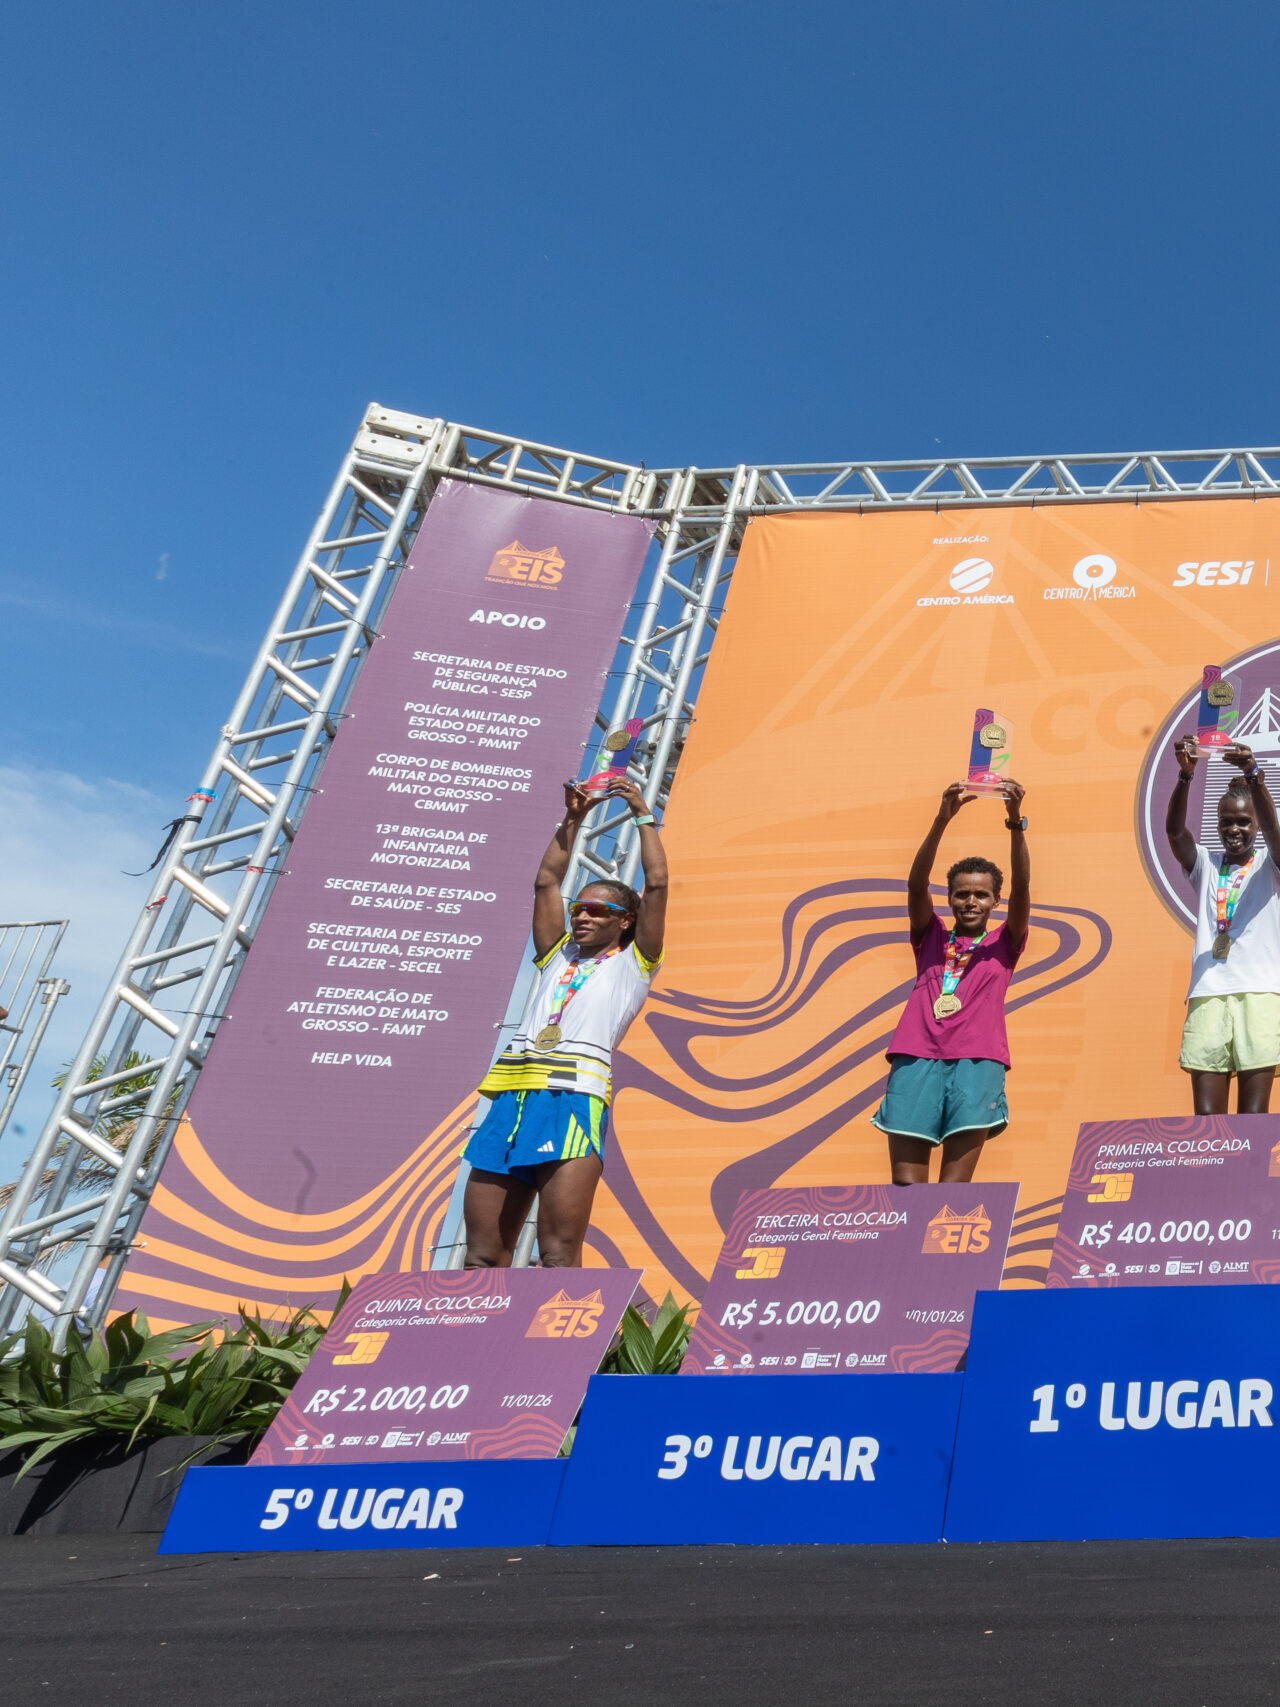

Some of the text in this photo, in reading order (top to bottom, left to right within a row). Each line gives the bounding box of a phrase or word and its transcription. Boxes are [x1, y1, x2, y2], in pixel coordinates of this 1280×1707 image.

[933, 534, 989, 544] REALIZAÇÃO:
[916, 593, 1014, 606] CENTRO AMÉRICA
[1043, 587, 1084, 600] CENTRO
[470, 609, 546, 630] APOIO
[412, 651, 567, 679] SECRETARIA DE ESTADO
[434, 667, 537, 688] DE SEGURANÇA
[432, 679, 532, 699] PÚBLICA SESP
[404, 702, 541, 726] POLÍCIA MILITAR DO
[408, 716, 528, 738] ESTADO DE MATO
[408, 730, 521, 750] GROSSO PMMT
[376, 753, 532, 779] CORPO DE BOMBEIROS
[368, 766, 531, 792] MILITAR DO ESTADO DE
[387, 782, 493, 802] MATO GROSSO
[414, 799, 469, 813] CBMMT
[401, 826, 465, 841] BRIGADA
[468, 832, 488, 843] DE
[383, 839, 469, 856] INFANTARIA
[370, 852, 470, 871] MOTORIZADA
[324, 878, 496, 902] SECRETARIA DE ESTADO
[351, 895, 462, 914] DE SAÚDE SES
[307, 922, 482, 946] SECRETARIA DE ESTADO
[307, 938, 473, 960] DE CULTURA, ESPORTE
[327, 955, 442, 974] E LAZER SECEL
[316, 987, 433, 1004] FEDERAÇÃO DE
[287, 1001, 448, 1021] ATLETISMO DE MATO
[302, 1018, 426, 1036] GROSSO FAMT
[311, 1052, 392, 1067] HELP VIDA
[1098, 1139, 1250, 1157] PRIMEIRA COLOCADA
[1094, 1156, 1224, 1170] Categoria Geral Feminina
[755, 1212, 907, 1228] TERCEIRA COLOCADA
[748, 1229, 879, 1244] Categoria Geral Feminina
[1079, 1219, 1251, 1248] R$ 40.000,00
[365, 1296, 511, 1314] QUINTA COLOCADA
[720, 1299, 880, 1329] R$ 5.000,00
[355, 1313, 487, 1329] Categoria Geral Feminina
[303, 1384, 469, 1416] R$ 2.000,00
[501, 1394, 553, 1408] 11/01/26
[1099, 1378, 1273, 1430] LUGAR
[721, 1436, 879, 1481] LUGAR
[317, 1488, 464, 1530] LUGAR
